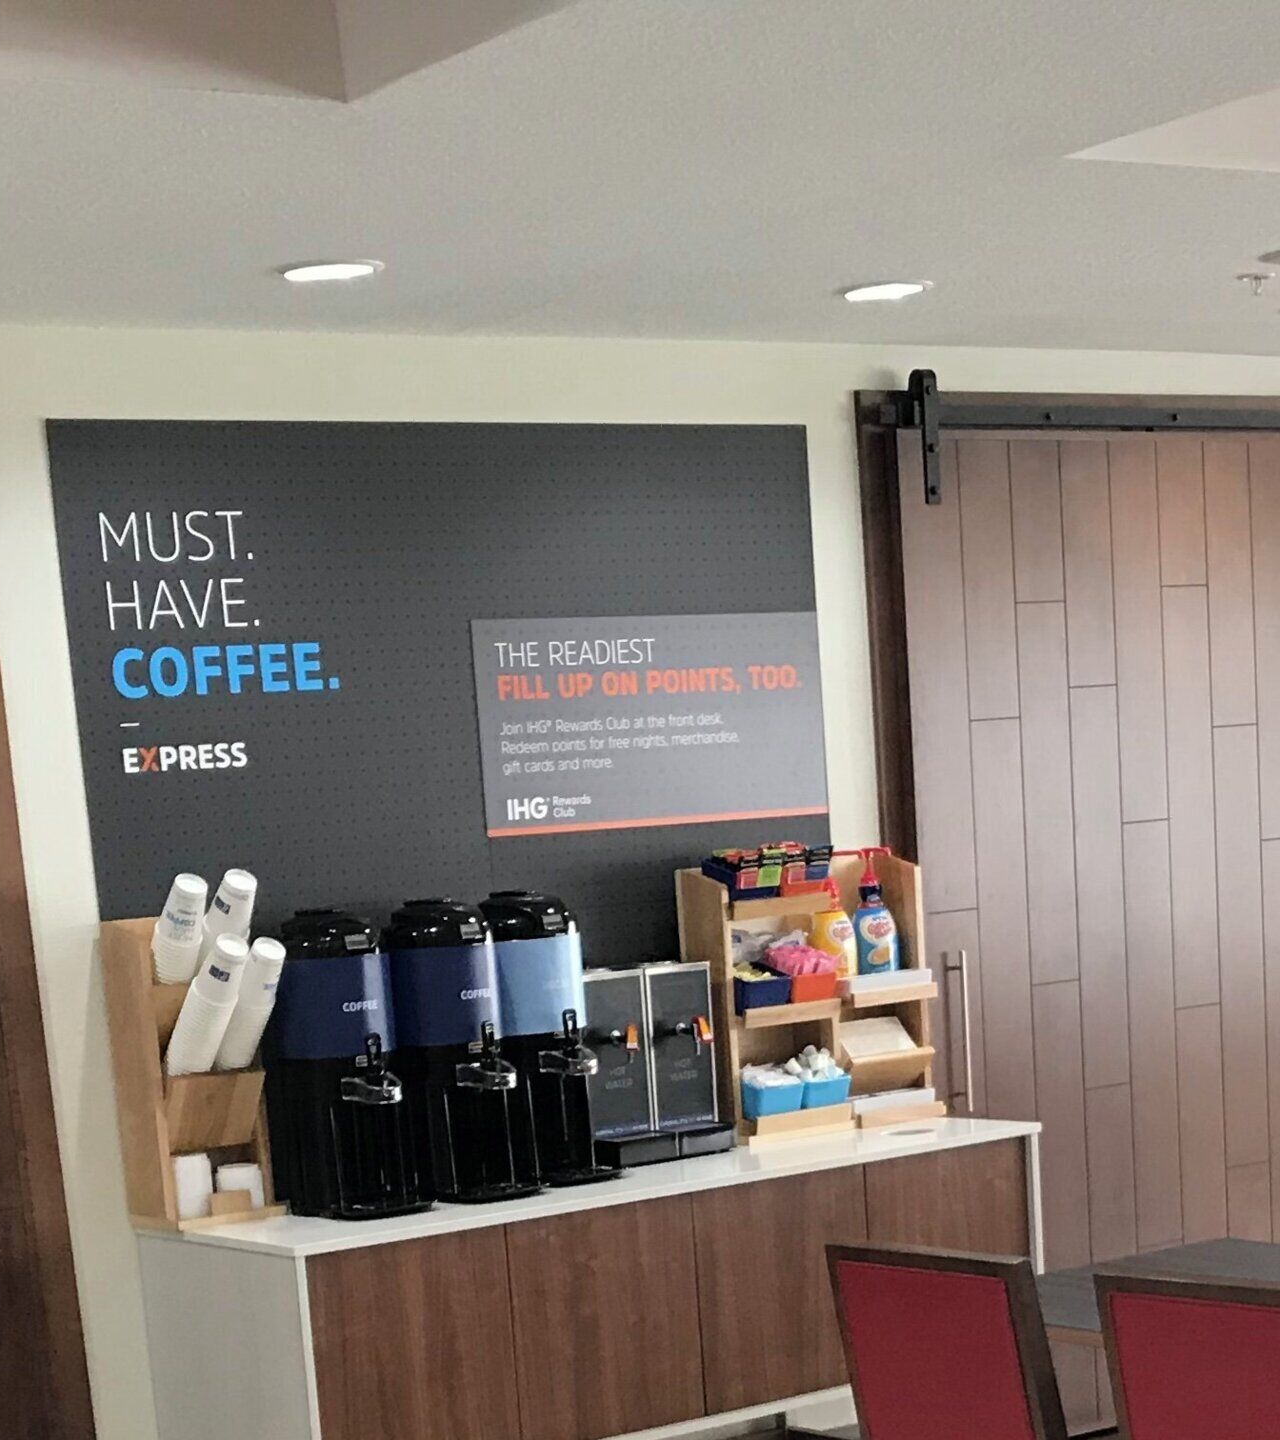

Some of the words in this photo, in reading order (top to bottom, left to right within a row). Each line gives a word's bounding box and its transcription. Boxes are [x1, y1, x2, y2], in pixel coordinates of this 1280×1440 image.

[98, 510, 254, 562] MUST.
[106, 578, 260, 631] HAVE.
[494, 641, 539, 667] THE
[548, 638, 656, 666] READIEST
[112, 642, 340, 699] COFFEE.
[496, 674, 551, 701] FILL
[558, 672, 593, 699] UP
[601, 671, 638, 697] ON
[646, 667, 742, 695] POINTS,
[747, 664, 802, 691] TOO.
[500, 722, 523, 735] Join
[555, 719, 603, 732] Rewards
[606, 716, 630, 730] Club
[634, 716, 644, 729] at
[647, 715, 666, 728] the
[668, 713, 694, 727] front
[501, 741, 549, 754] Redeem
[551, 739, 587, 755] points
[589, 736, 605, 750] for
[608, 735, 630, 749] free
[122, 742, 249, 774] EXPRESS
[502, 761, 521, 776] gift
[524, 759, 555, 773] cards
[557, 757, 580, 771] and
[552, 794, 592, 807] Rewards
[553, 807, 576, 818] Club
[342, 999, 378, 1013] COFFEE
